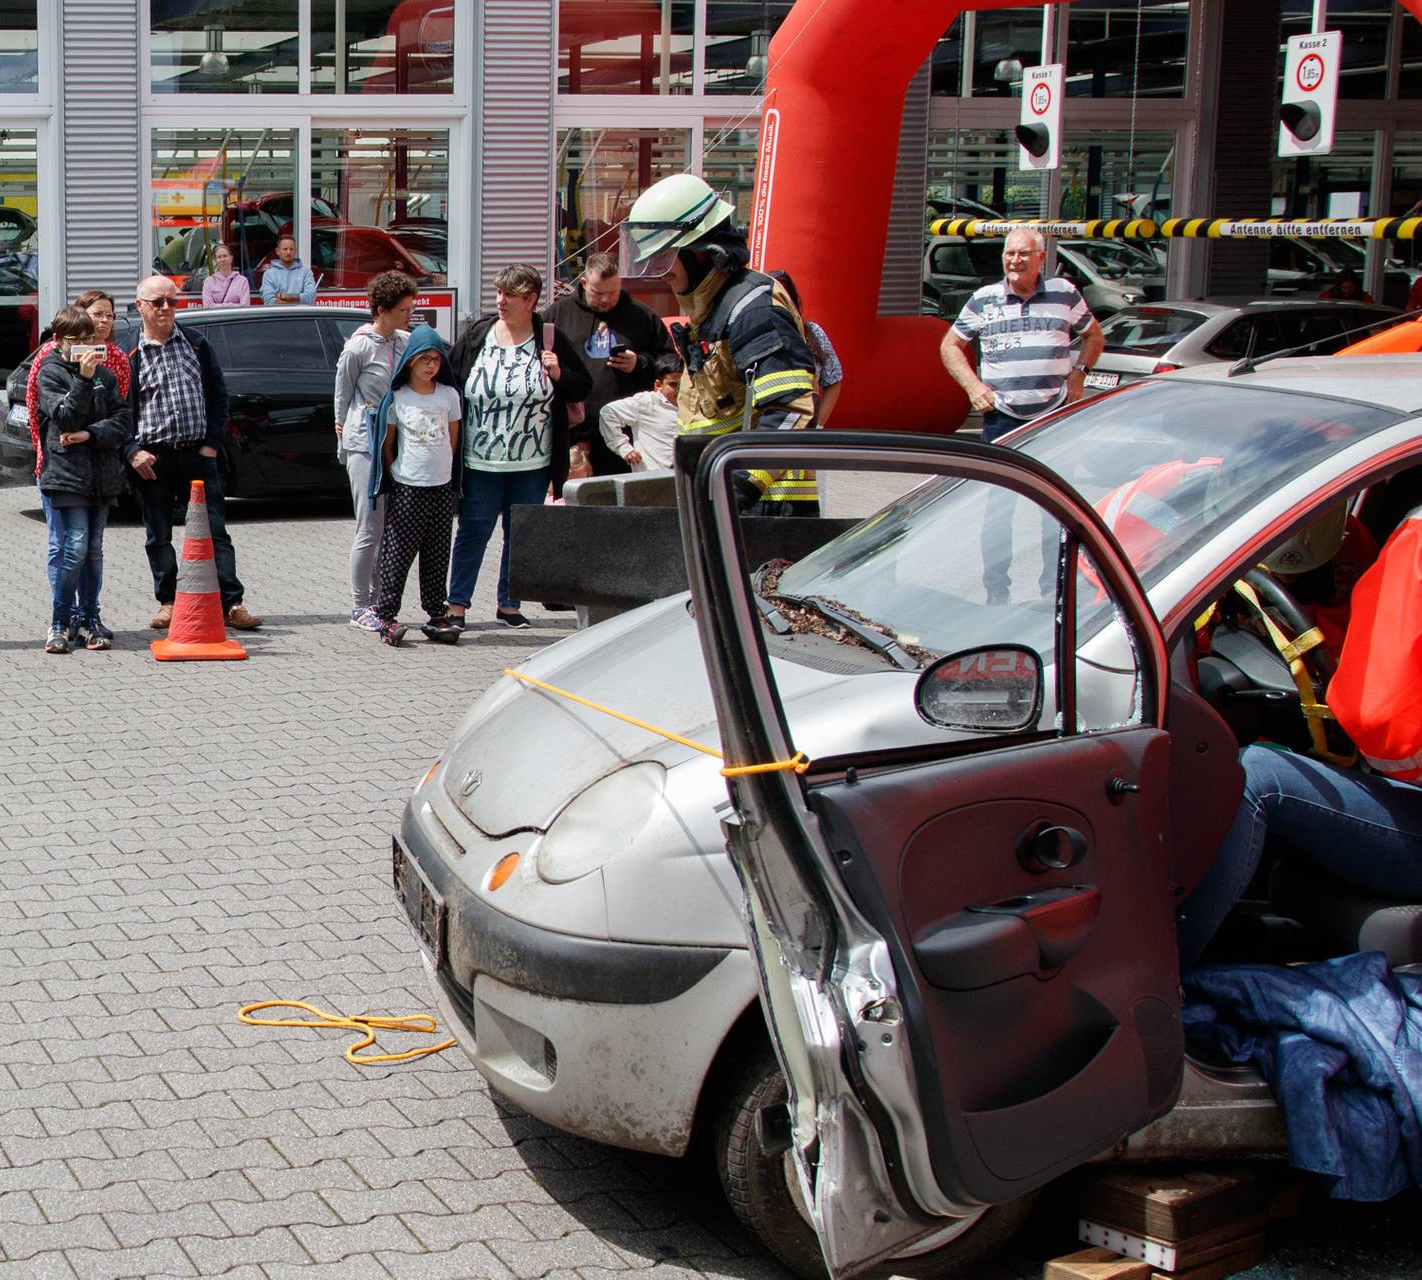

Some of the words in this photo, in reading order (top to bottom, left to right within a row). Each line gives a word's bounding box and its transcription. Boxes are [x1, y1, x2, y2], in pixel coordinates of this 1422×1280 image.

[1299, 40, 1320, 49] Kasse
[1322, 38, 1328, 47] 2
[1032, 71, 1048, 79] Kasse
[762, 153, 771, 182] beste
[760, 183, 768, 198] die
[981, 224, 1012, 235] Antenne
[1037, 224, 1078, 235] entfernen
[1230, 224, 1272, 236] Antenne
[1277, 224, 1302, 236] bitte
[1306, 224, 1362, 236] entfernen
